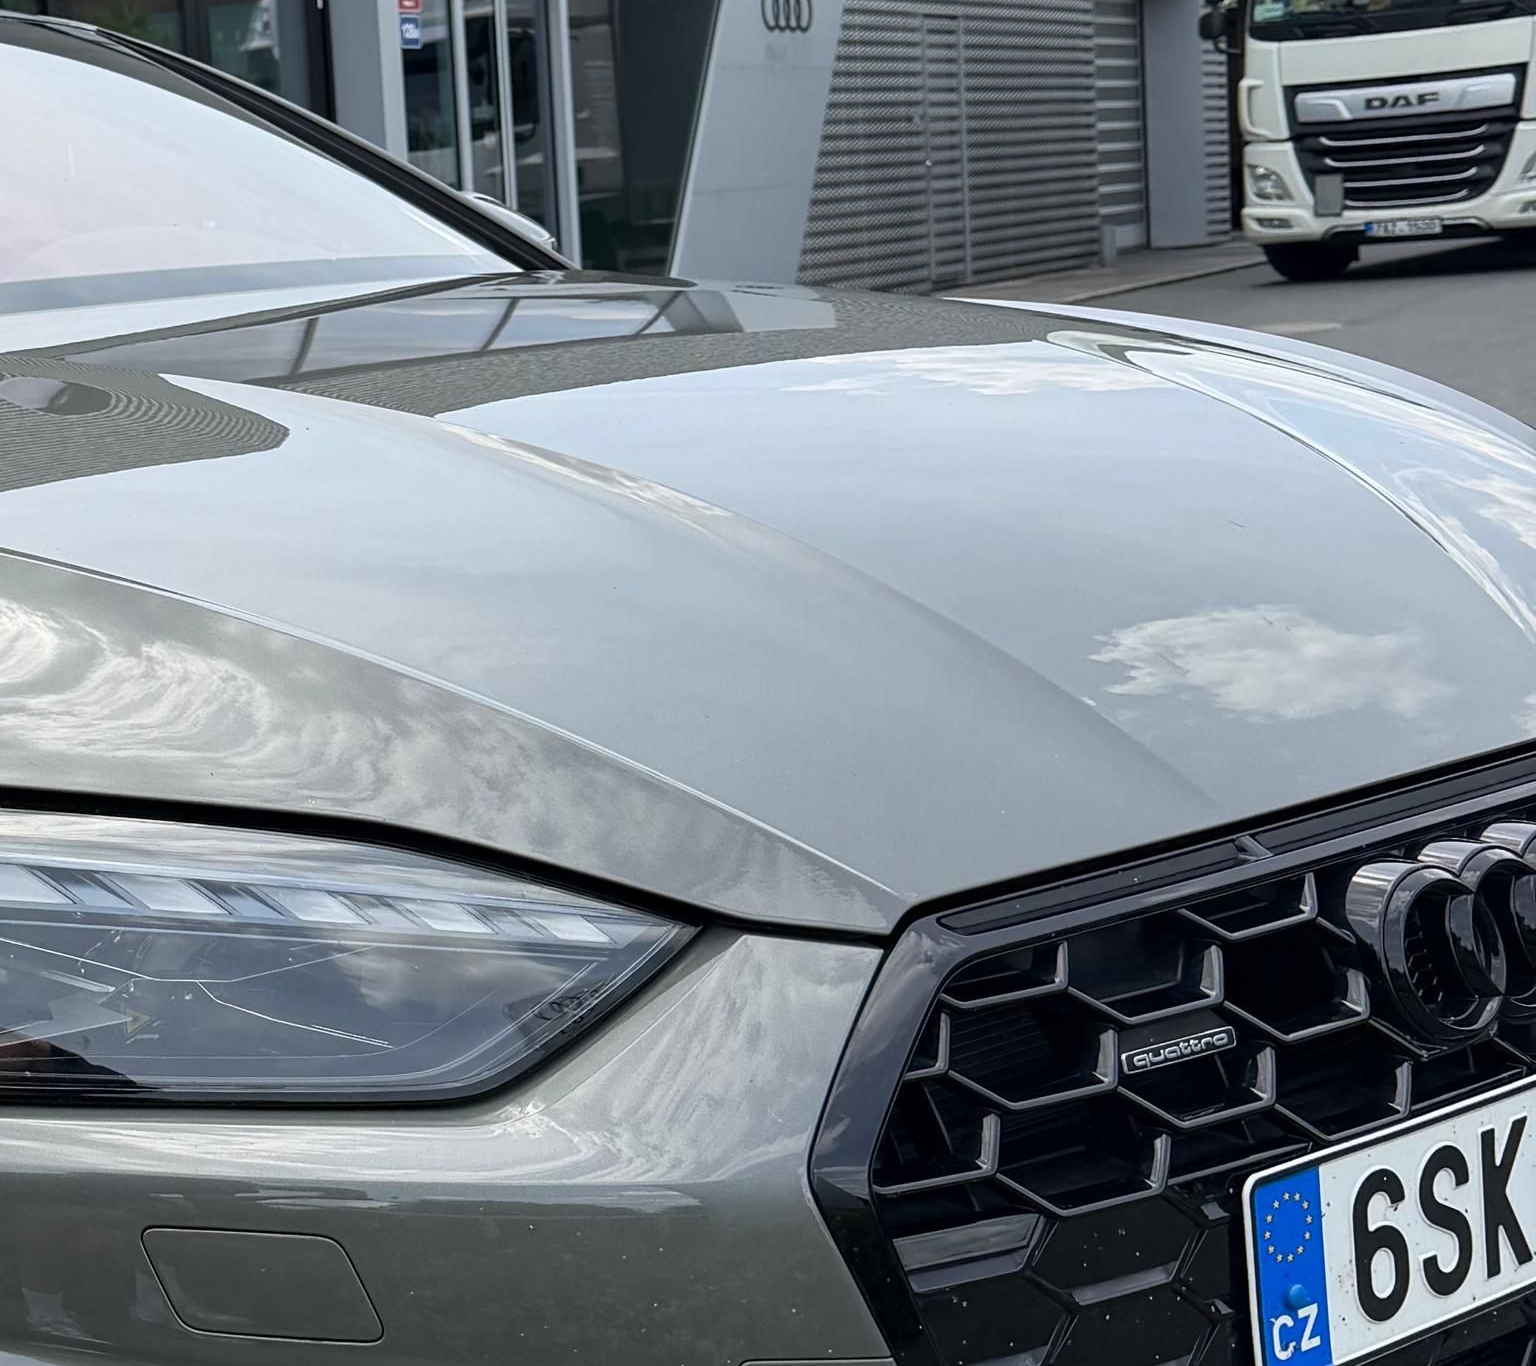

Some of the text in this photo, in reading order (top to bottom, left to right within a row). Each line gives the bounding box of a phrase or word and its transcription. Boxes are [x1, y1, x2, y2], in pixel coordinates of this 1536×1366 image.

[1365, 92, 1440, 110] DAF
[1133, 1033, 1228, 1067] quattro
[1353, 1115, 1534, 1323] 6SK
[1272, 1303, 1321, 1361] CZ
